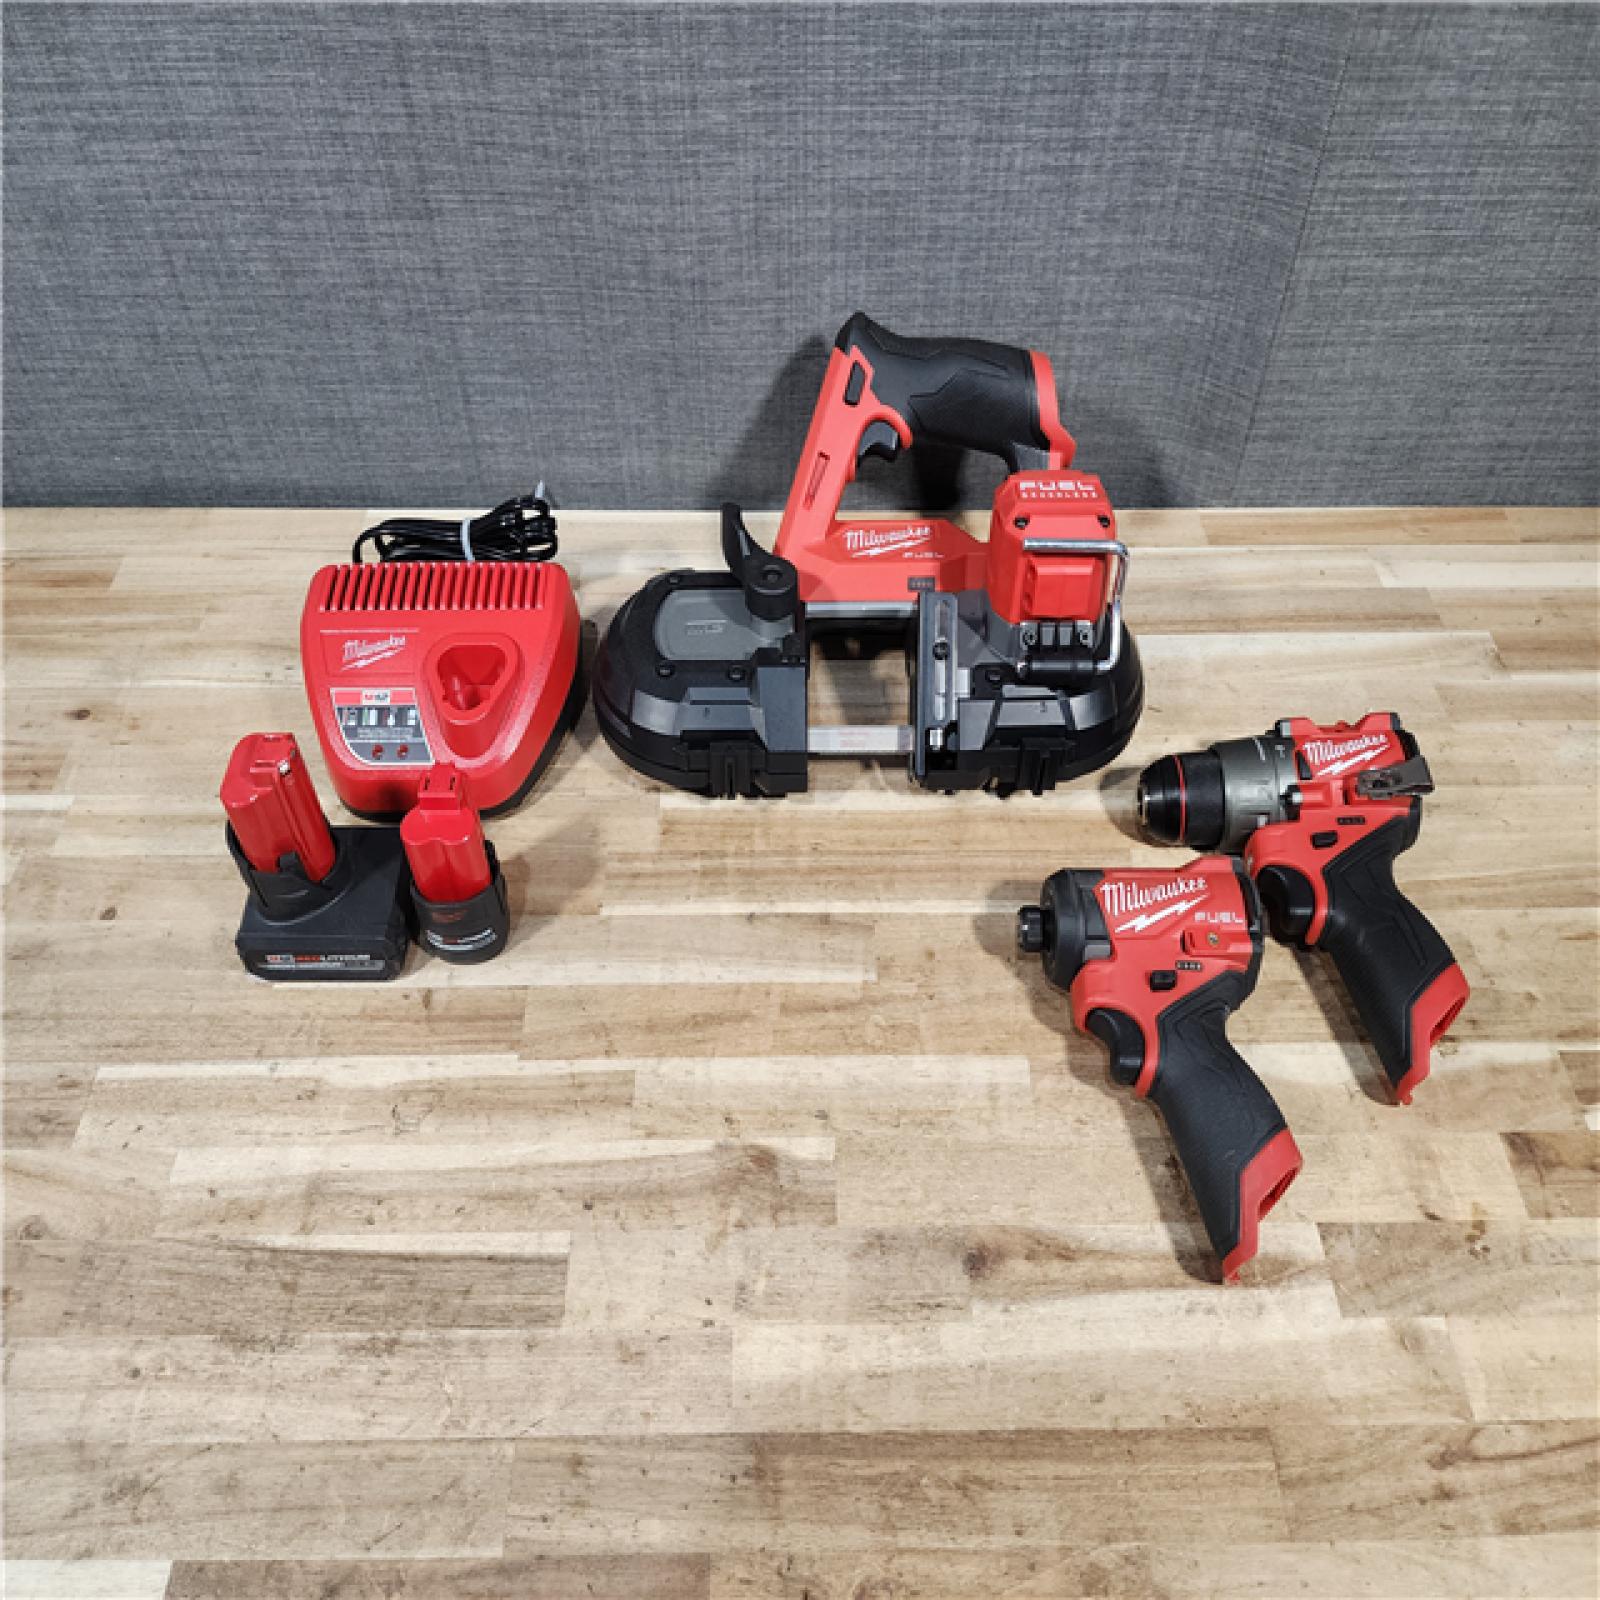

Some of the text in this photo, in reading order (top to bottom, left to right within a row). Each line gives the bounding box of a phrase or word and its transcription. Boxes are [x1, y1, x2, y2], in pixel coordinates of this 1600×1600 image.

[1020, 481, 1095, 491] FUEL
[1303, 734, 1388, 766] Milwaukee
[1100, 877, 1208, 917] Milwaukee
[1195, 912, 1244, 923] FUEL
